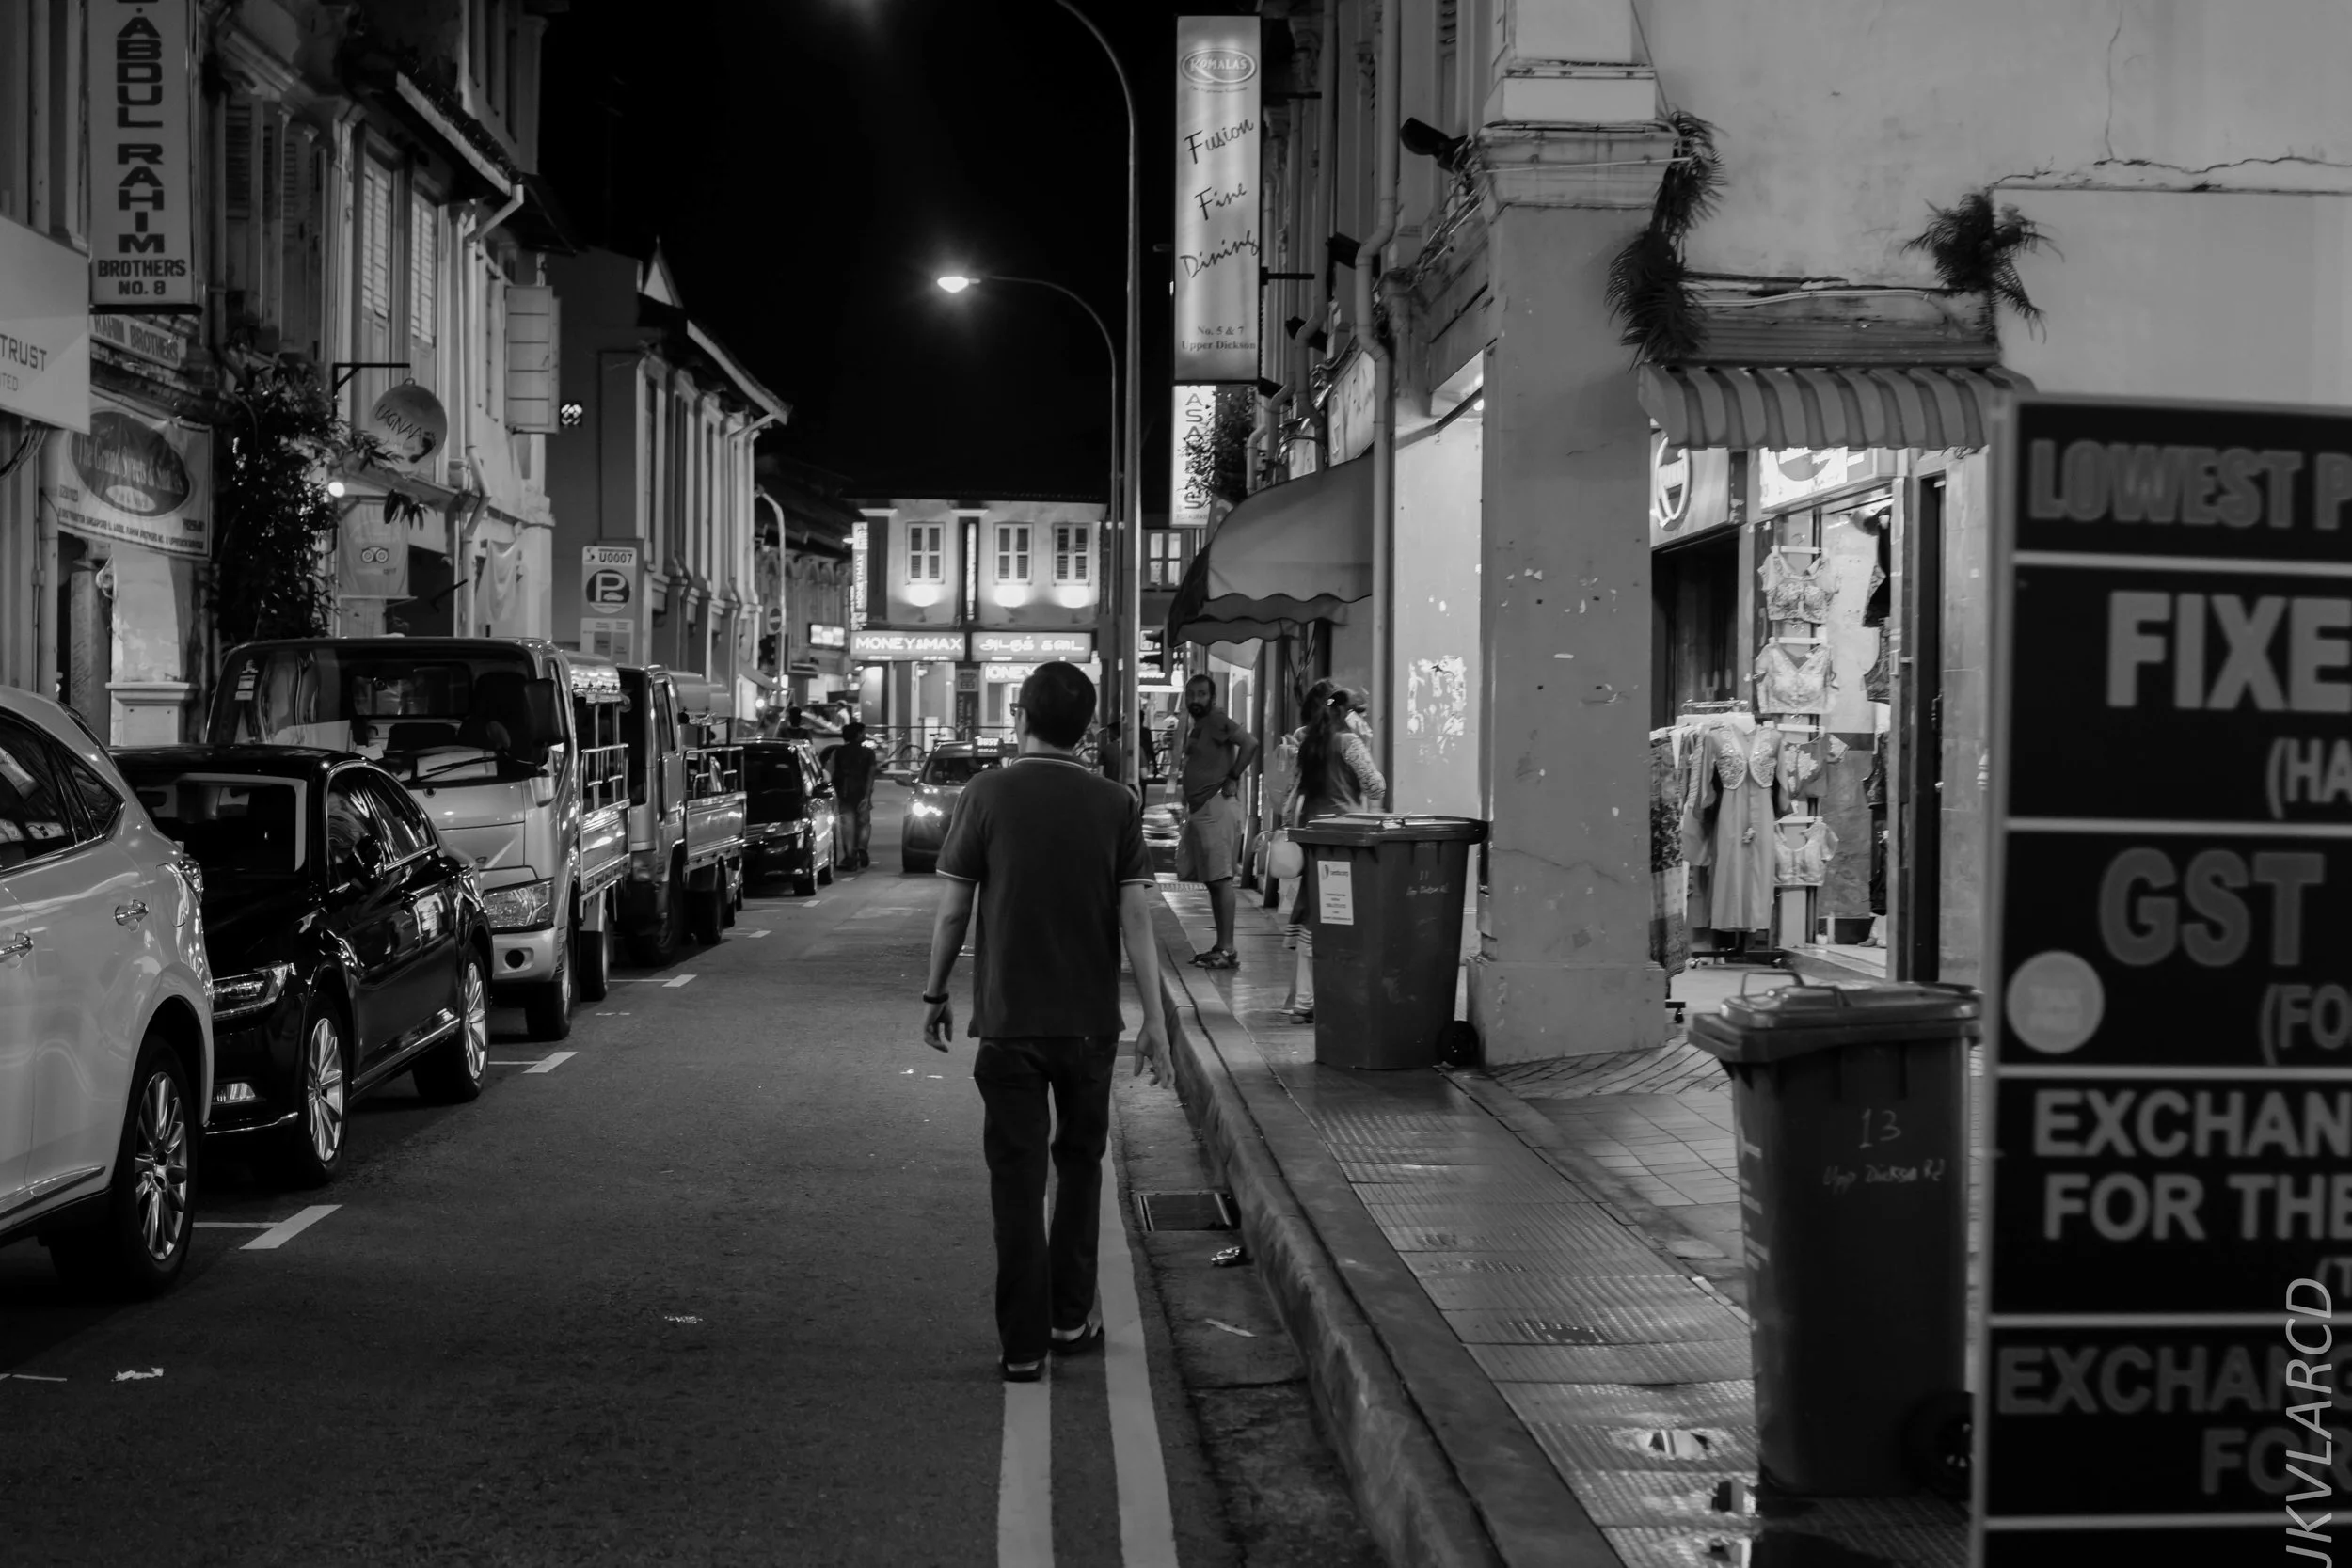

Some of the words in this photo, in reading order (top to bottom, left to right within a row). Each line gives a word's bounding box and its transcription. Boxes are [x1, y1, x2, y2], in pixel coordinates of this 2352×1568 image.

[117, 16, 163, 128] ABDUL
[1184, 119, 1254, 164] Fusion
[118, 143, 165, 253] RAHIM
[1194, 183, 1248, 221] Fine
[98, 260, 186, 277] BROTHERS
[1179, 230, 1261, 278] Dining
[119, 281, 149, 294] NO.
[153, 281, 166, 294] 8
[0, 333, 47, 371] TRUST
[130, 325, 179, 365] BROTHERS
[1182, 341, 1213, 352] Upper
[1216, 341, 1256, 350] Dickson
[2028, 439, 2303, 528] LOWEST
[599, 553, 633, 563] U0007
[2106, 591, 2352, 712] FIXE
[2097, 847, 2327, 967] GST
[1858, 1108, 1902, 1148] 13
[2033, 1088, 2352, 1158] EXCHAN
[2043, 1172, 2206, 1242] FOR
